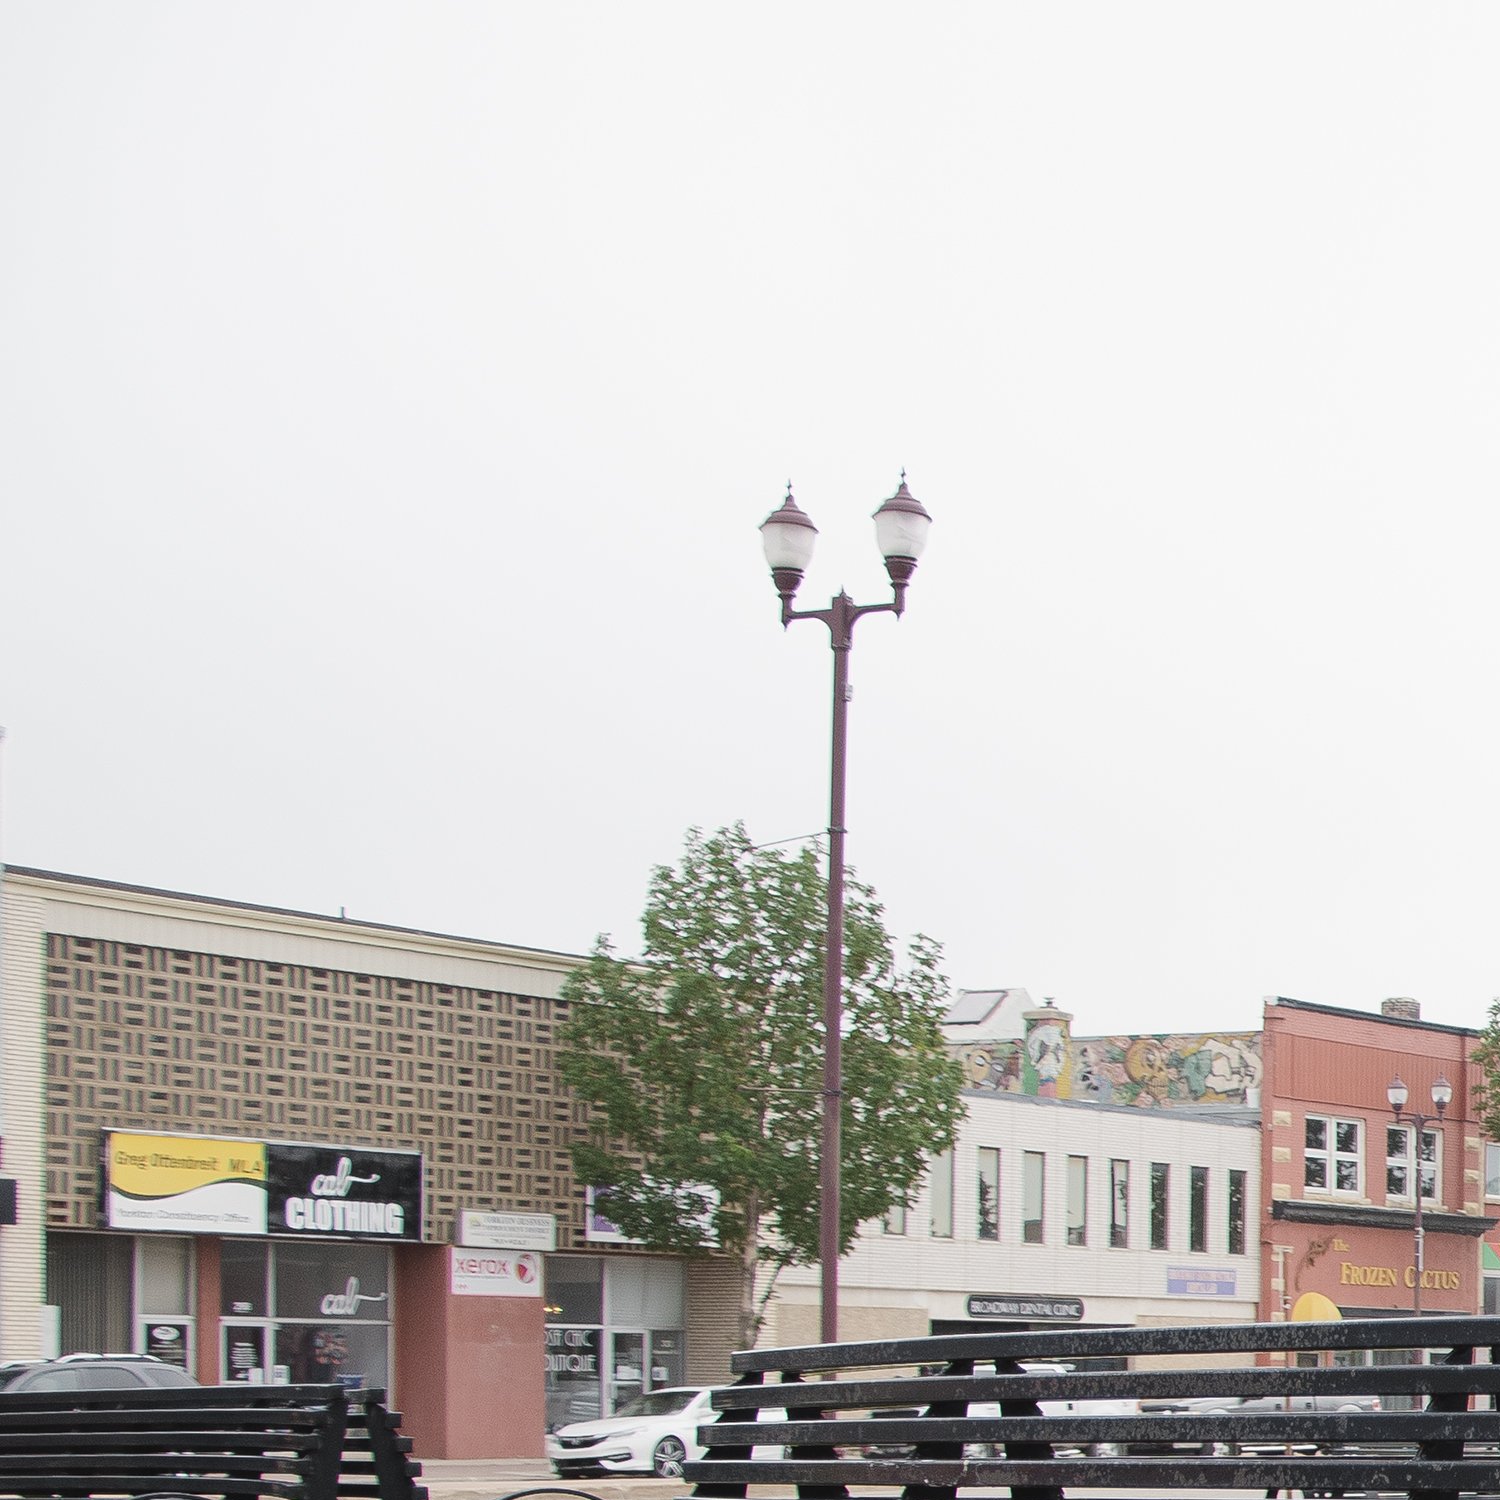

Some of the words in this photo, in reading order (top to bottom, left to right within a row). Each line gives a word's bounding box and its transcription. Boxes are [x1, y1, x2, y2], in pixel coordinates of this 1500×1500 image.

[115, 1150, 148, 1170] Greg
[229, 1157, 263, 1173] MLA
[285, 1196, 405, 1234] CLOTHING
[454, 1257, 508, 1275] xerox
[1340, 1262, 1398, 1287] FROZEN
[1404, 1266, 1461, 1290] CCTUS
